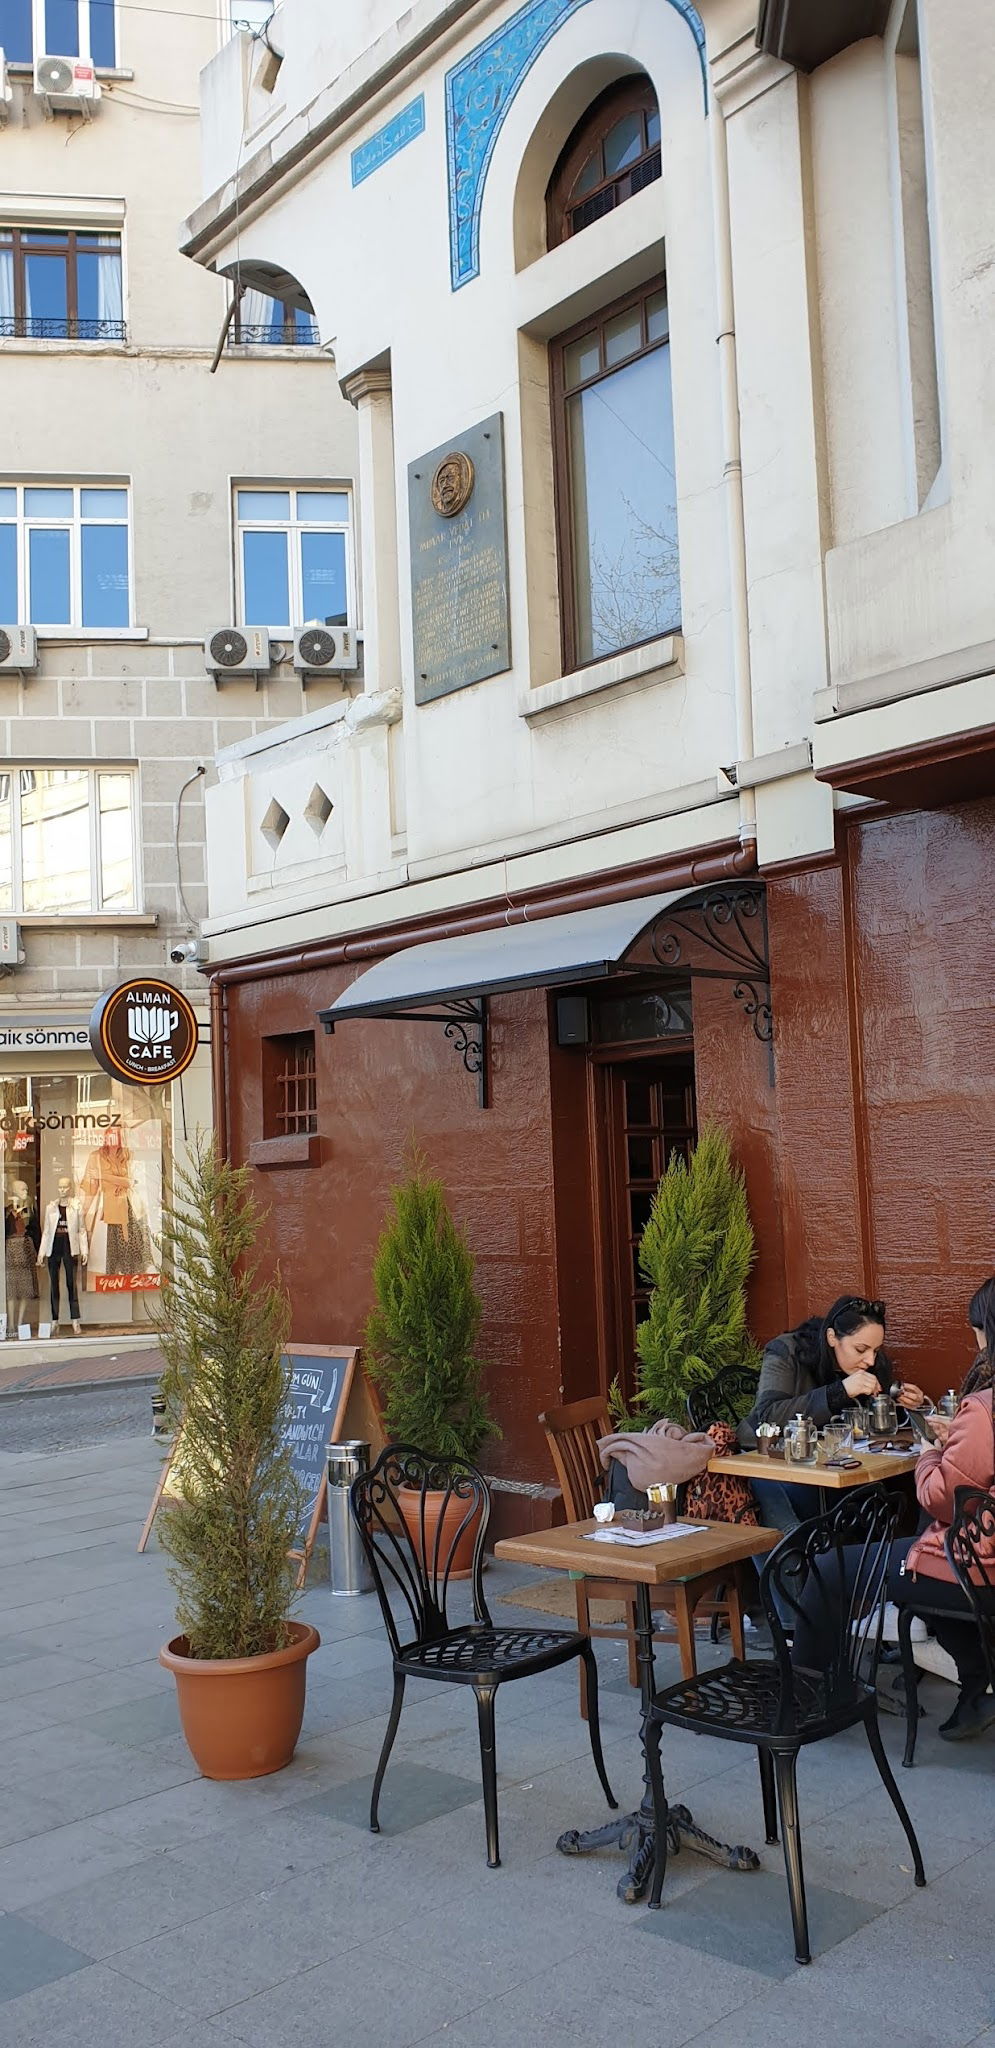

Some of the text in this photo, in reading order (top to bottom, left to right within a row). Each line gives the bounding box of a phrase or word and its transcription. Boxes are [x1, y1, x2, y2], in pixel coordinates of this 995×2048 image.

[126, 992, 170, 1005] ALMAN
[25, 1029, 91, 1044] sönme
[129, 1044, 172, 1058] CAFE
[125, 1058, 176, 1072] LUNCH BREAKFAST
[38, 1111, 122, 1129] sönmez
